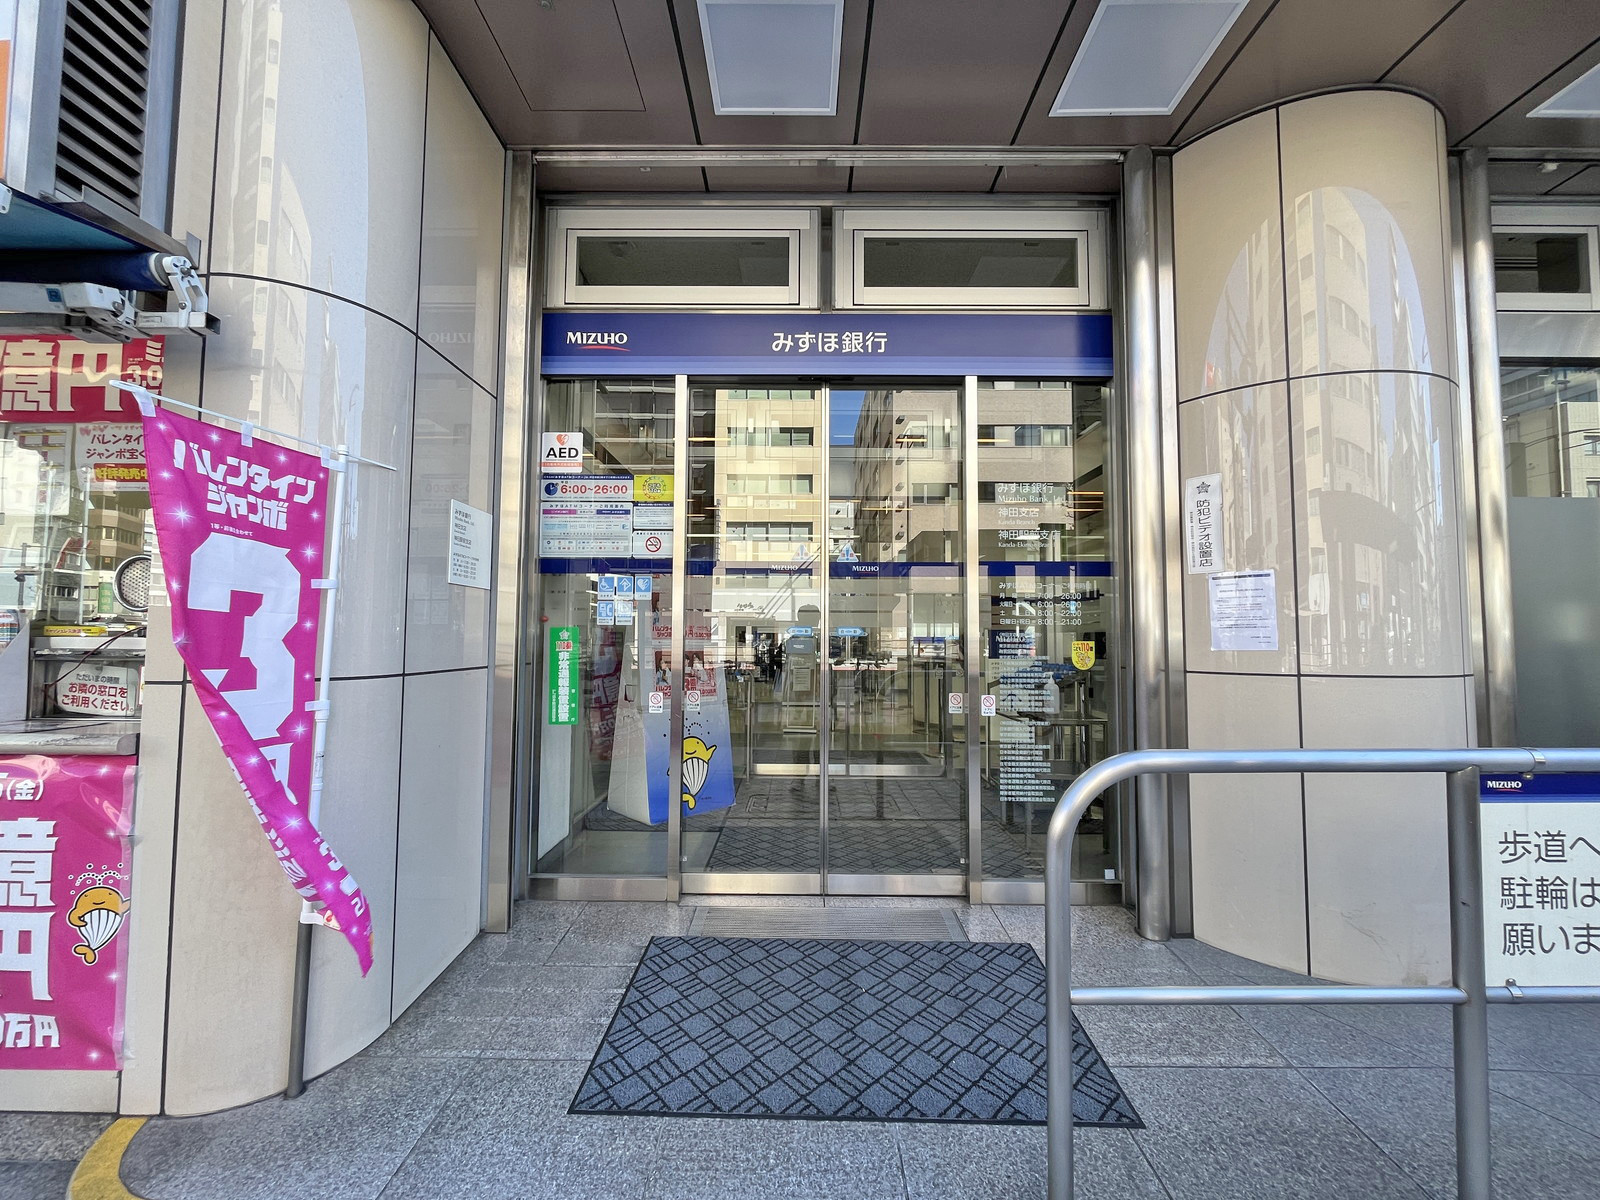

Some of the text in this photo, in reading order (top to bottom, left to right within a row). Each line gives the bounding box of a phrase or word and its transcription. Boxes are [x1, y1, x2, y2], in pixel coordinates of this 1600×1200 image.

[566, 331, 628, 345] MIZUHO
[771, 331, 888, 353] みずほ銀行
[91, 434, 144, 445] バレンタイ
[86, 448, 146, 459] ジャンボ宝く
[545, 447, 579, 458] AED
[173, 438, 316, 504] バレンタイン
[997, 482, 1054, 494] みずほ銀行
[206, 482, 289, 531] ジャンボ
[998, 507, 1039, 517] 神田支店
[1196, 499, 1213, 567] 防犯ビデオ設置店
[187, 532, 301, 741] 3
[75, 673, 120, 684] ただいまの時間
[68, 682, 128, 699] お隣の窓口を
[61, 694, 134, 712] ご利用ください。
[1486, 780, 1522, 789] MIZUHO
[1498, 830, 1600, 864] 歩道へ
[1500, 875, 1600, 910] 駐輪は
[1502, 923, 1600, 956] 願いま
[0, 1012, 61, 1048] 万円
